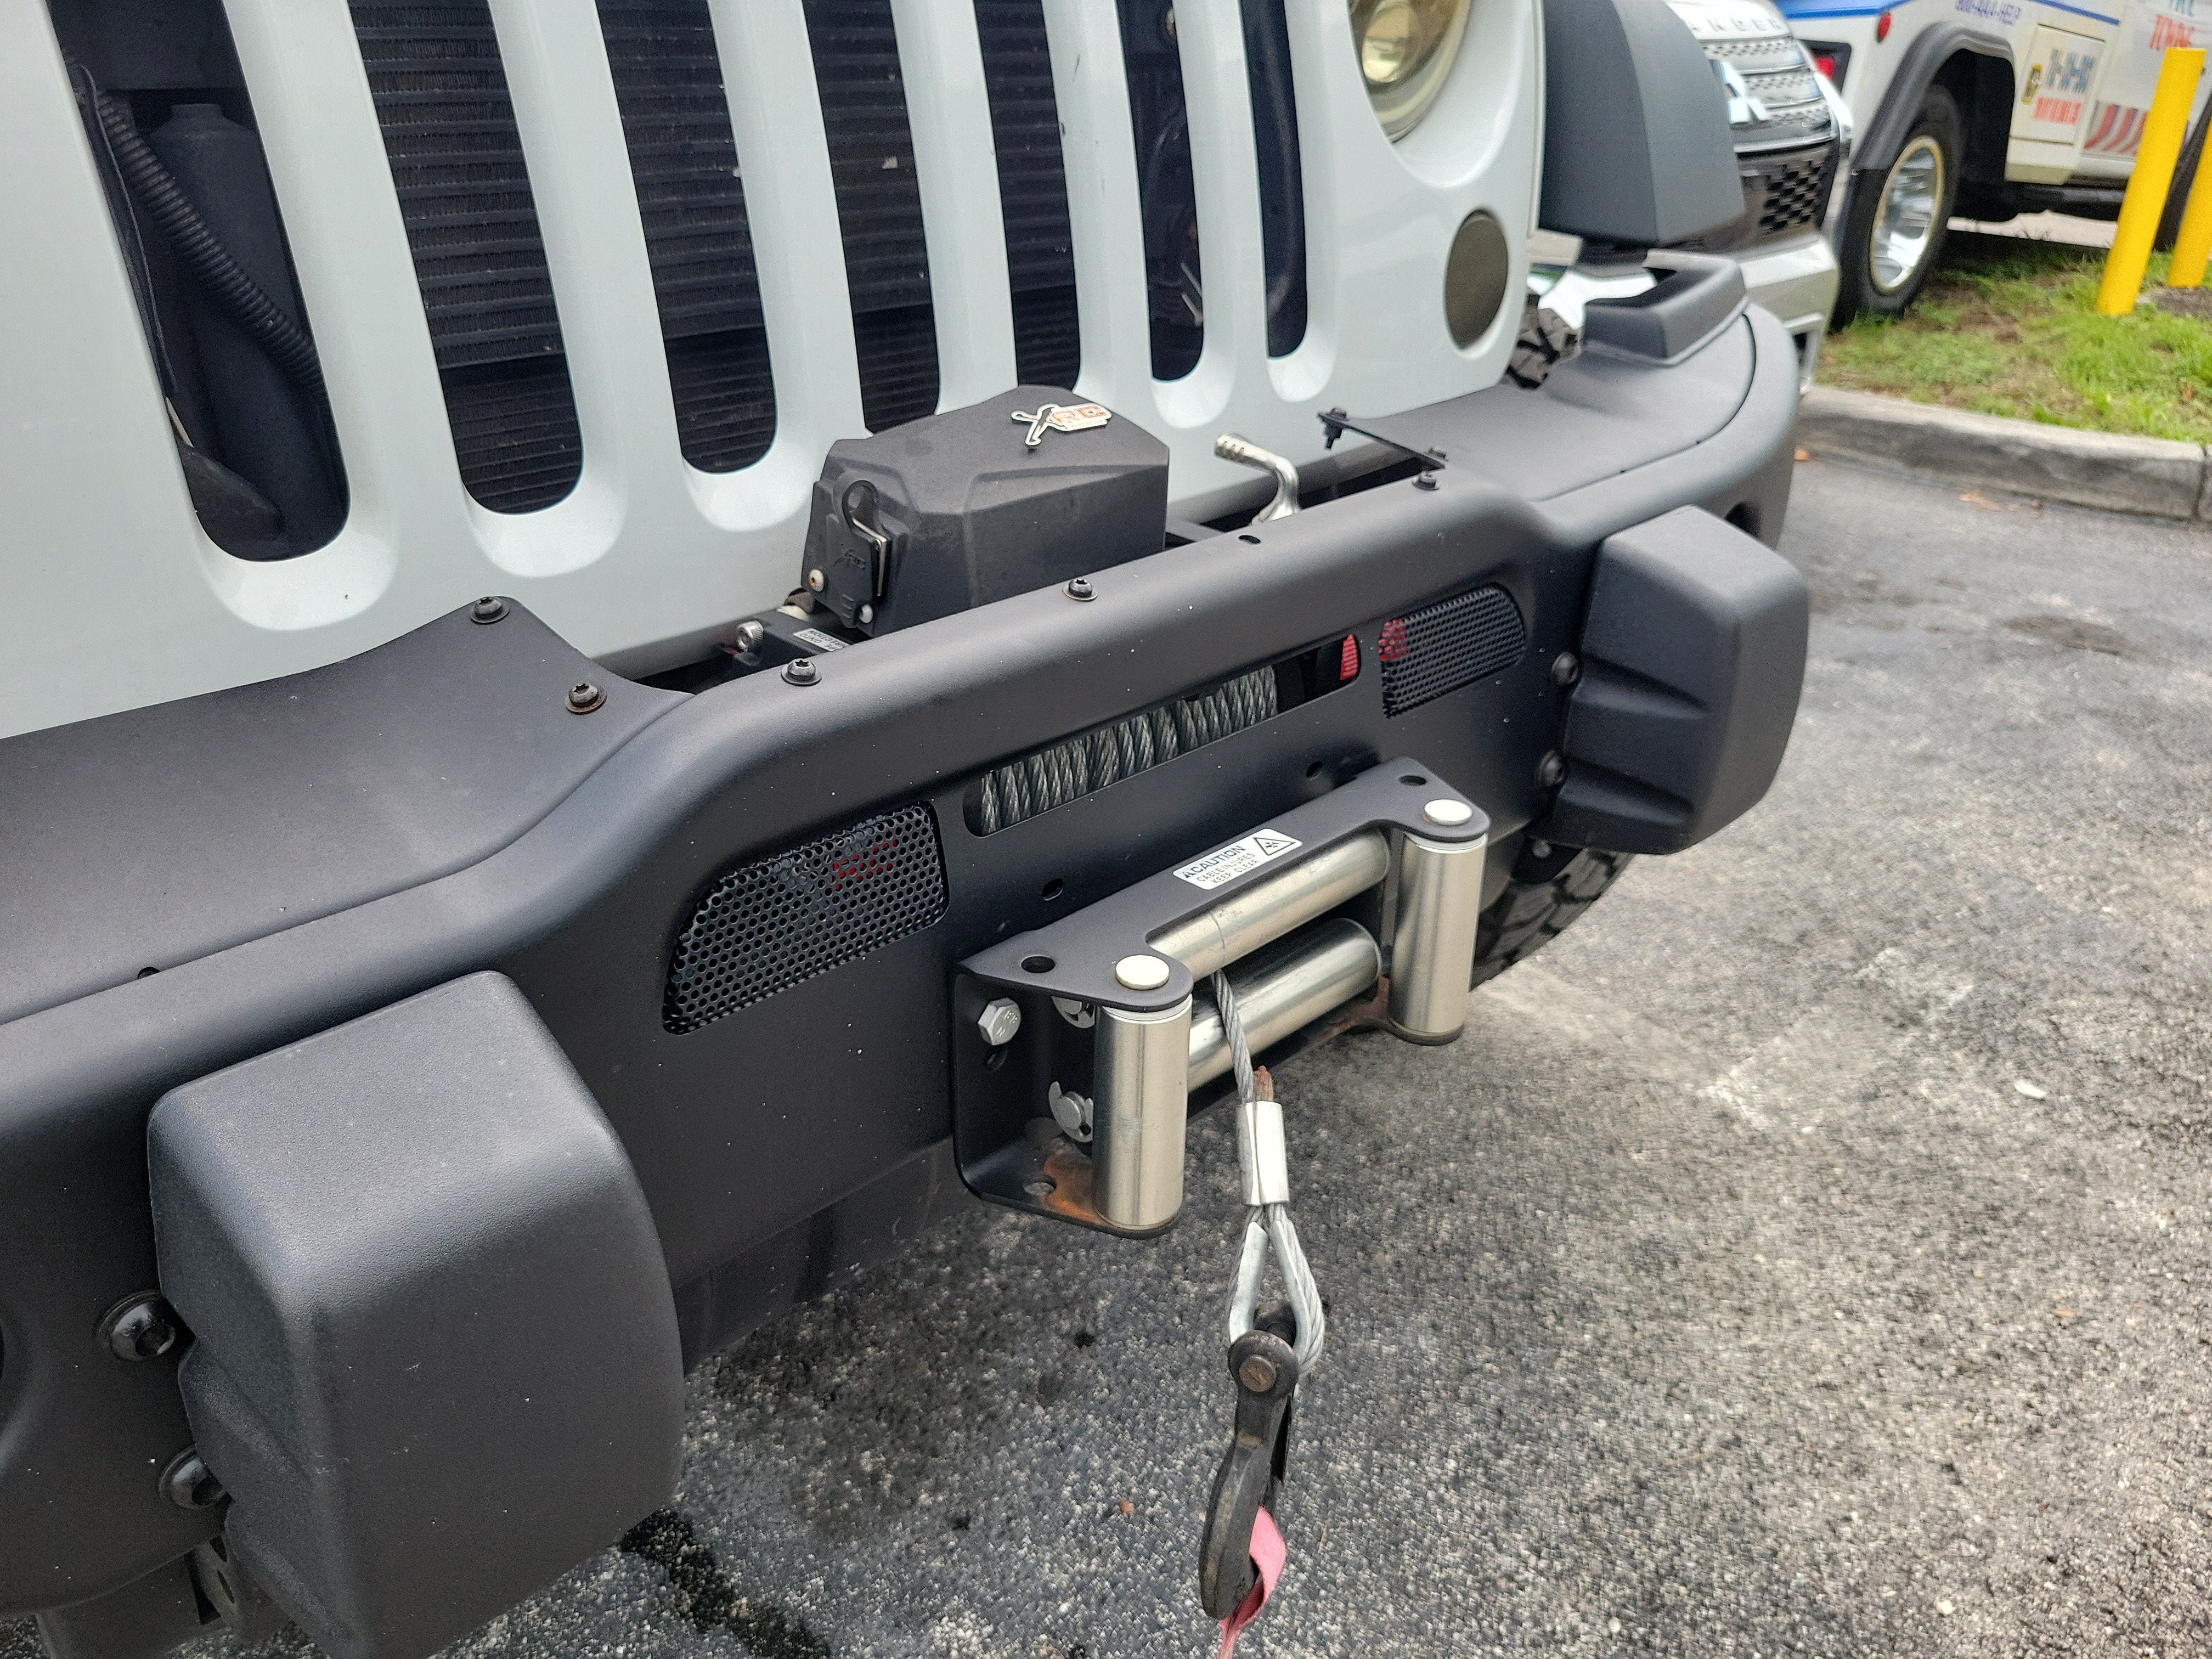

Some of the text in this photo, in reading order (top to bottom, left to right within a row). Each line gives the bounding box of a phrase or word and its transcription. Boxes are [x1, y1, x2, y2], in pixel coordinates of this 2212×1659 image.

[1191, 845, 1246, 873] CAUTION
[1211, 859, 1260, 884] KEEP CLEAR
[1196, 867, 1223, 882] CABLE
